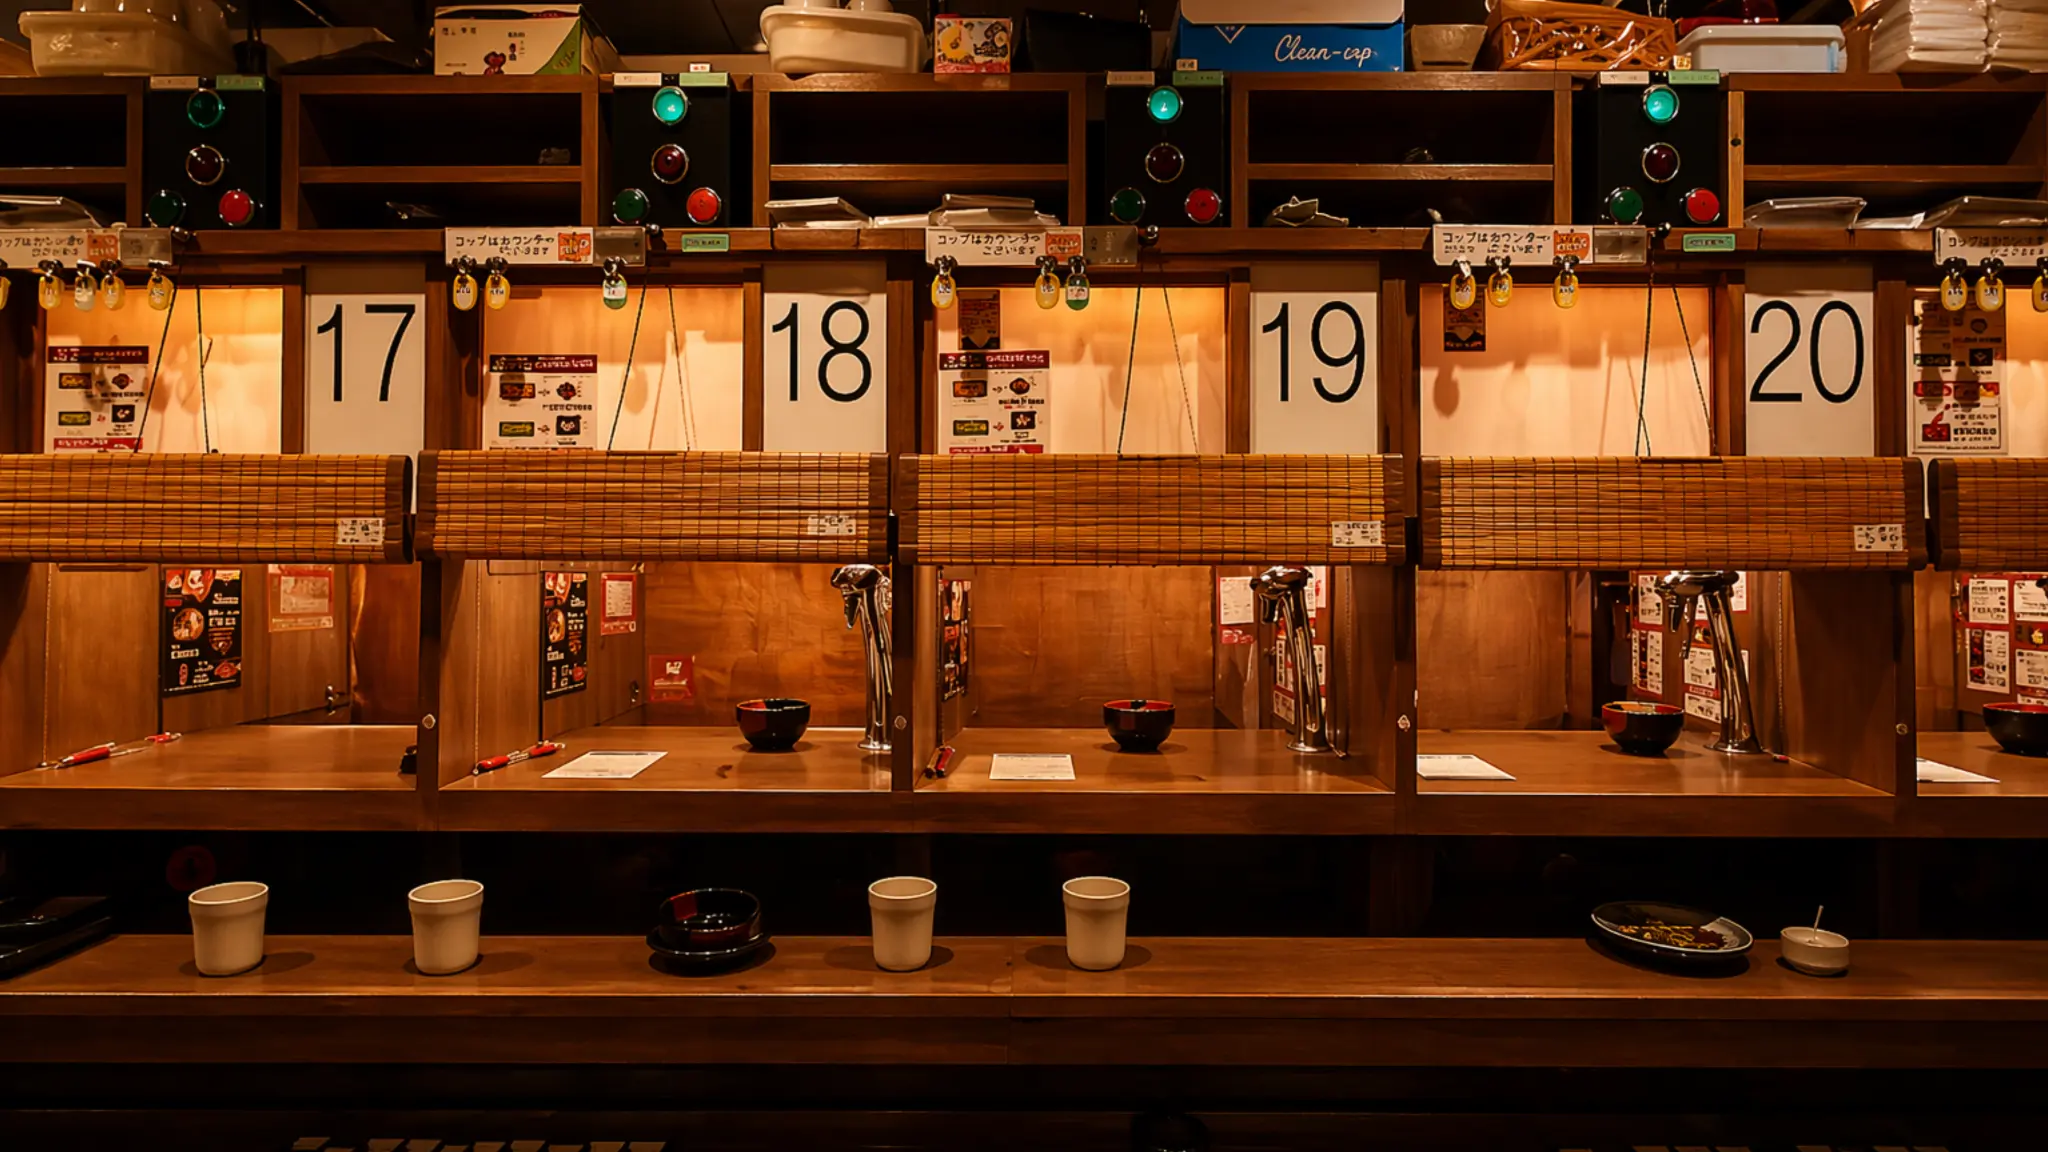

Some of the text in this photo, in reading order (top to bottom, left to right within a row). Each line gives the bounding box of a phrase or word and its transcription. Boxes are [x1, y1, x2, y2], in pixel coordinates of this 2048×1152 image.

[1274, 33, 1376, 68] Clean-cap
[317, 304, 416, 402] 17
[772, 301, 872, 402] 18
[1262, 301, 1366, 403] 19
[1749, 300, 1865, 403] 20
